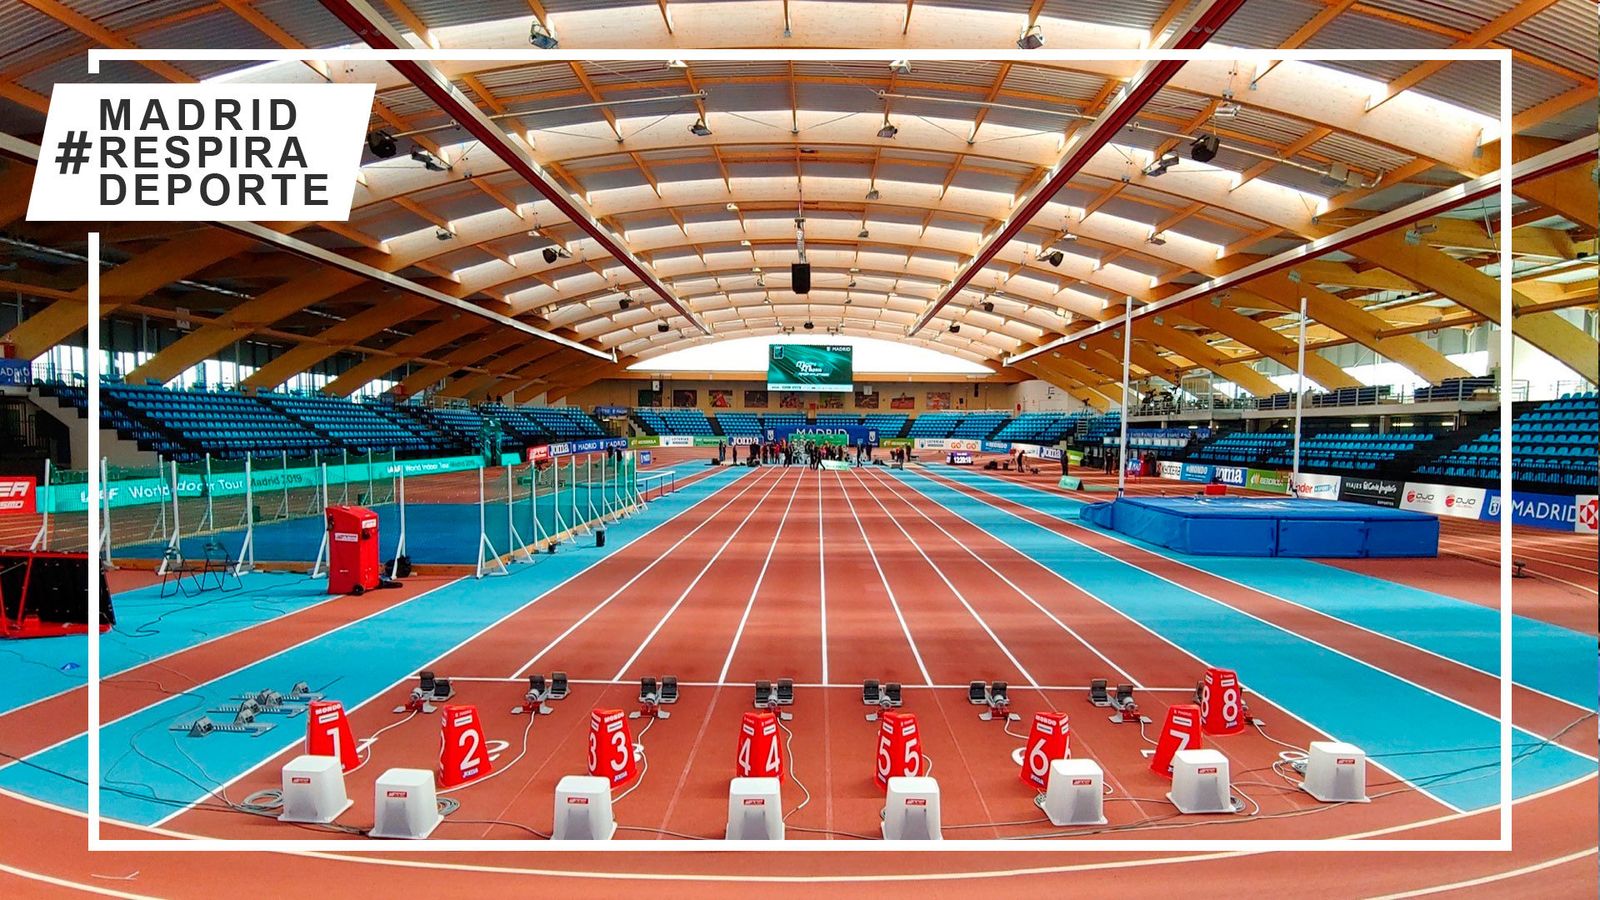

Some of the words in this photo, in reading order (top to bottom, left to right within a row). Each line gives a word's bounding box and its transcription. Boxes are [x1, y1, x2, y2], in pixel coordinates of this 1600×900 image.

[128, 483, 170, 499] World
[218, 479, 243, 490] Tour
[1222, 688, 1238, 722] 8
[458, 728, 480, 770] 2
[588, 732, 597, 772] 3
[610, 731, 628, 772] 3
[738, 737, 751, 776] 4
[766, 734, 780, 773] 4
[878, 735, 891, 776] 5
[904, 738, 920, 778] 5
[1029, 738, 1049, 776] 6
